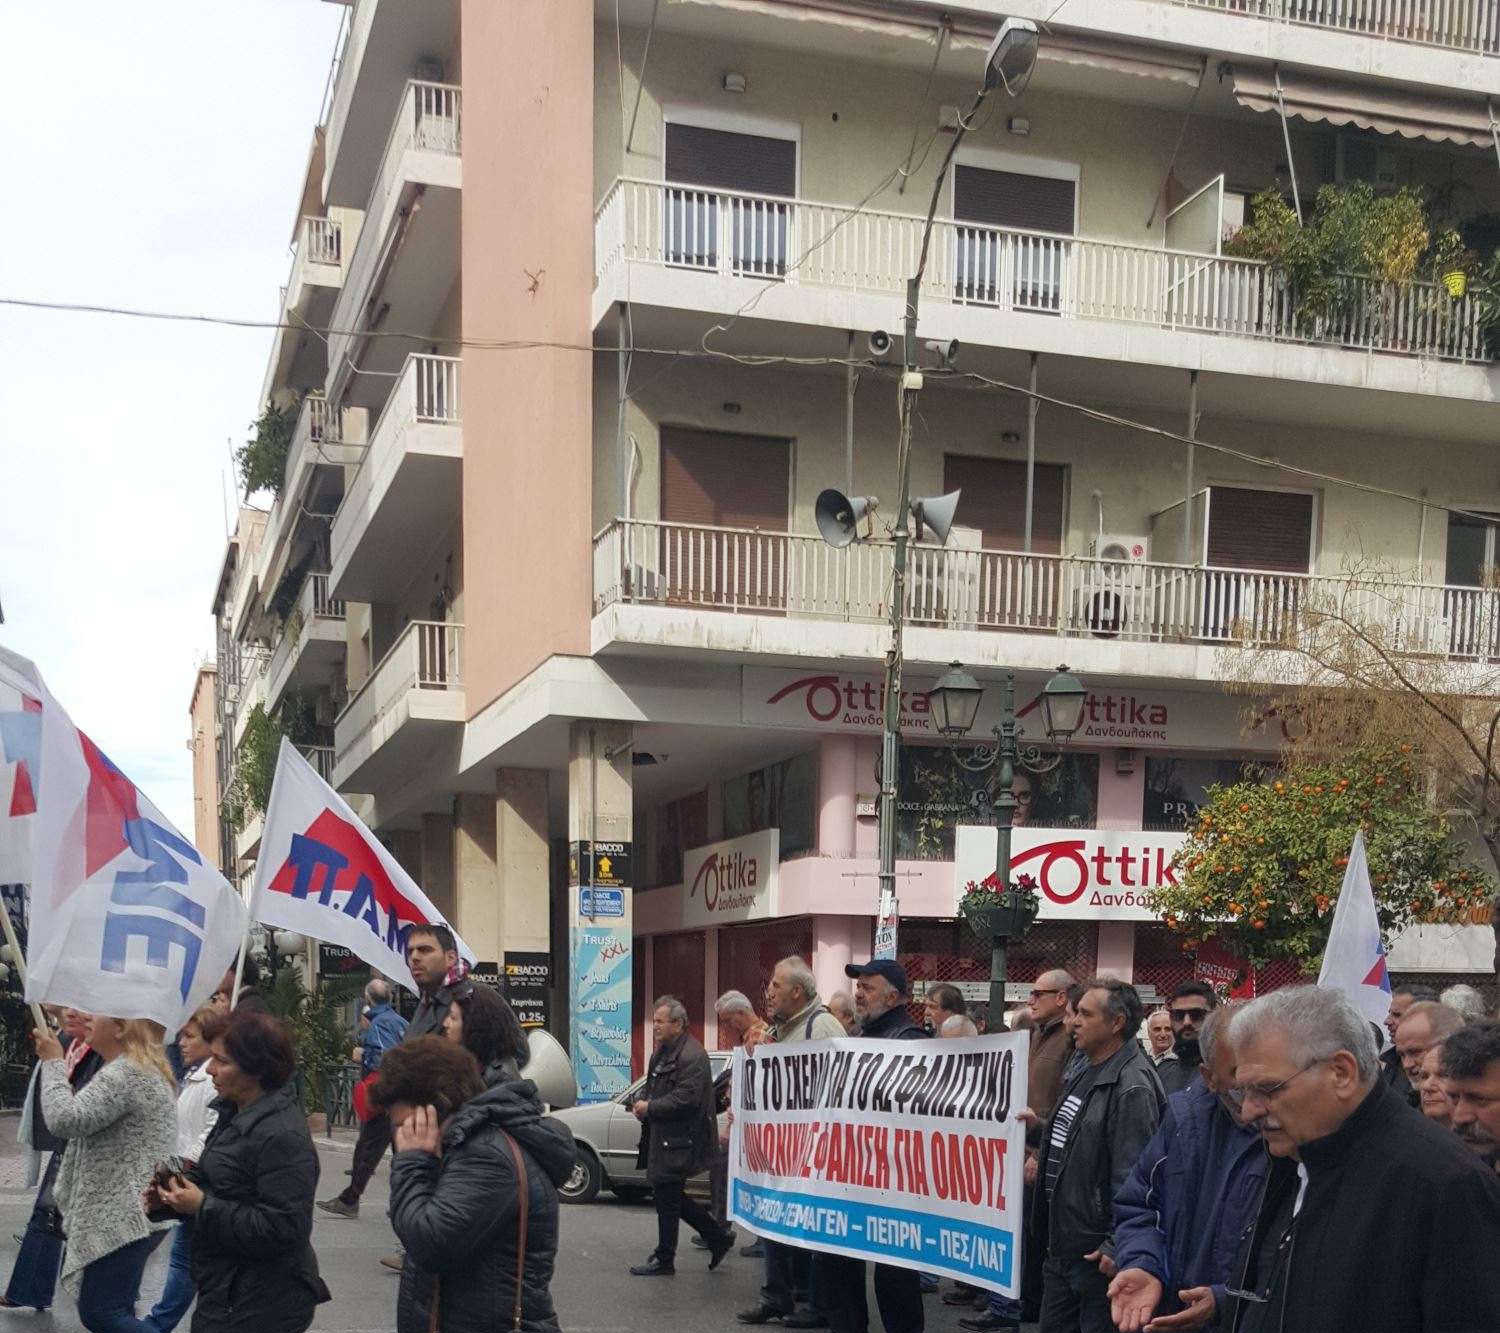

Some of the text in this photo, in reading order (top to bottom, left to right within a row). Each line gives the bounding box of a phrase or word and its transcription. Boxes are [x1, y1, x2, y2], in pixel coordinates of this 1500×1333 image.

[767, 676, 930, 721] Ottia
[843, 713, 929, 729] Δανδοάκης
[1163, 802, 1201, 814] PRA
[986, 840, 1179, 905] Ottik
[930, 1131, 1008, 1212] ΟΛΟΥΣ
